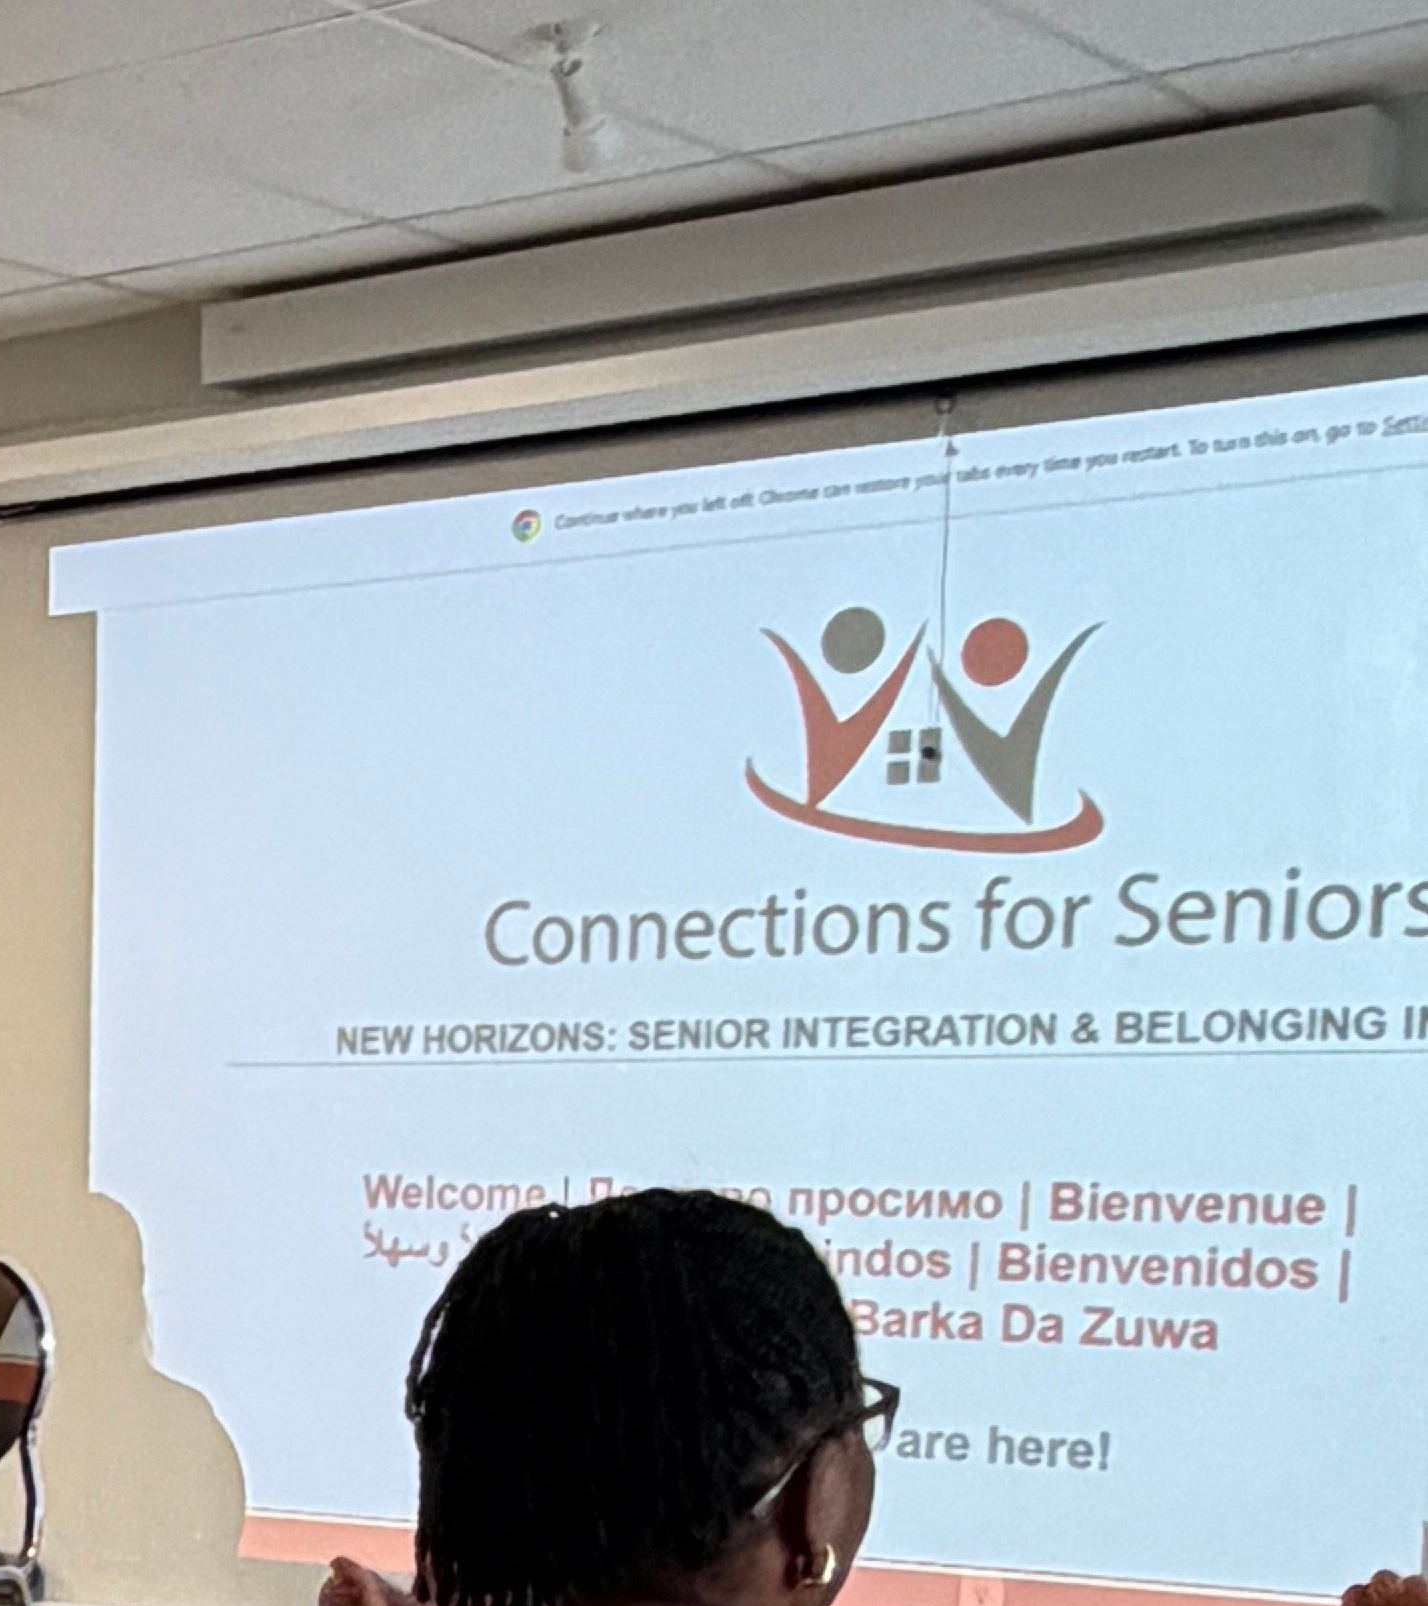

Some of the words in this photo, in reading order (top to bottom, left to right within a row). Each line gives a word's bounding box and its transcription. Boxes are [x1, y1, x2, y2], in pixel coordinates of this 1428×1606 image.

[1085, 452, 1118, 473] you
[1254, 428, 1288, 448] this
[1325, 424, 1352, 444] go
[484, 887, 951, 966] Connections
[974, 875, 1092, 952] for
[336, 1024, 413, 1056] NEW
[422, 1020, 617, 1055] HORIZONS:
[628, 1018, 770, 1052] SENIOR
[782, 1012, 1058, 1050] INTEGRATION
[1070, 1012, 1100, 1044] &
[1114, 1005, 1388, 1045] BELONGING
[362, 1173, 546, 1211] Welcome
[787, 1185, 1004, 1224] просимо
[1048, 1180, 1326, 1226] Bienvenue
[997, 1242, 1320, 1290] Bienvenidos
[850, 1297, 986, 1342] Barka
[1002, 1302, 1064, 1344] Da
[1078, 1305, 1218, 1352] Zuwa
[897, 1428, 972, 1461] are
[987, 1424, 1112, 1472] here!
